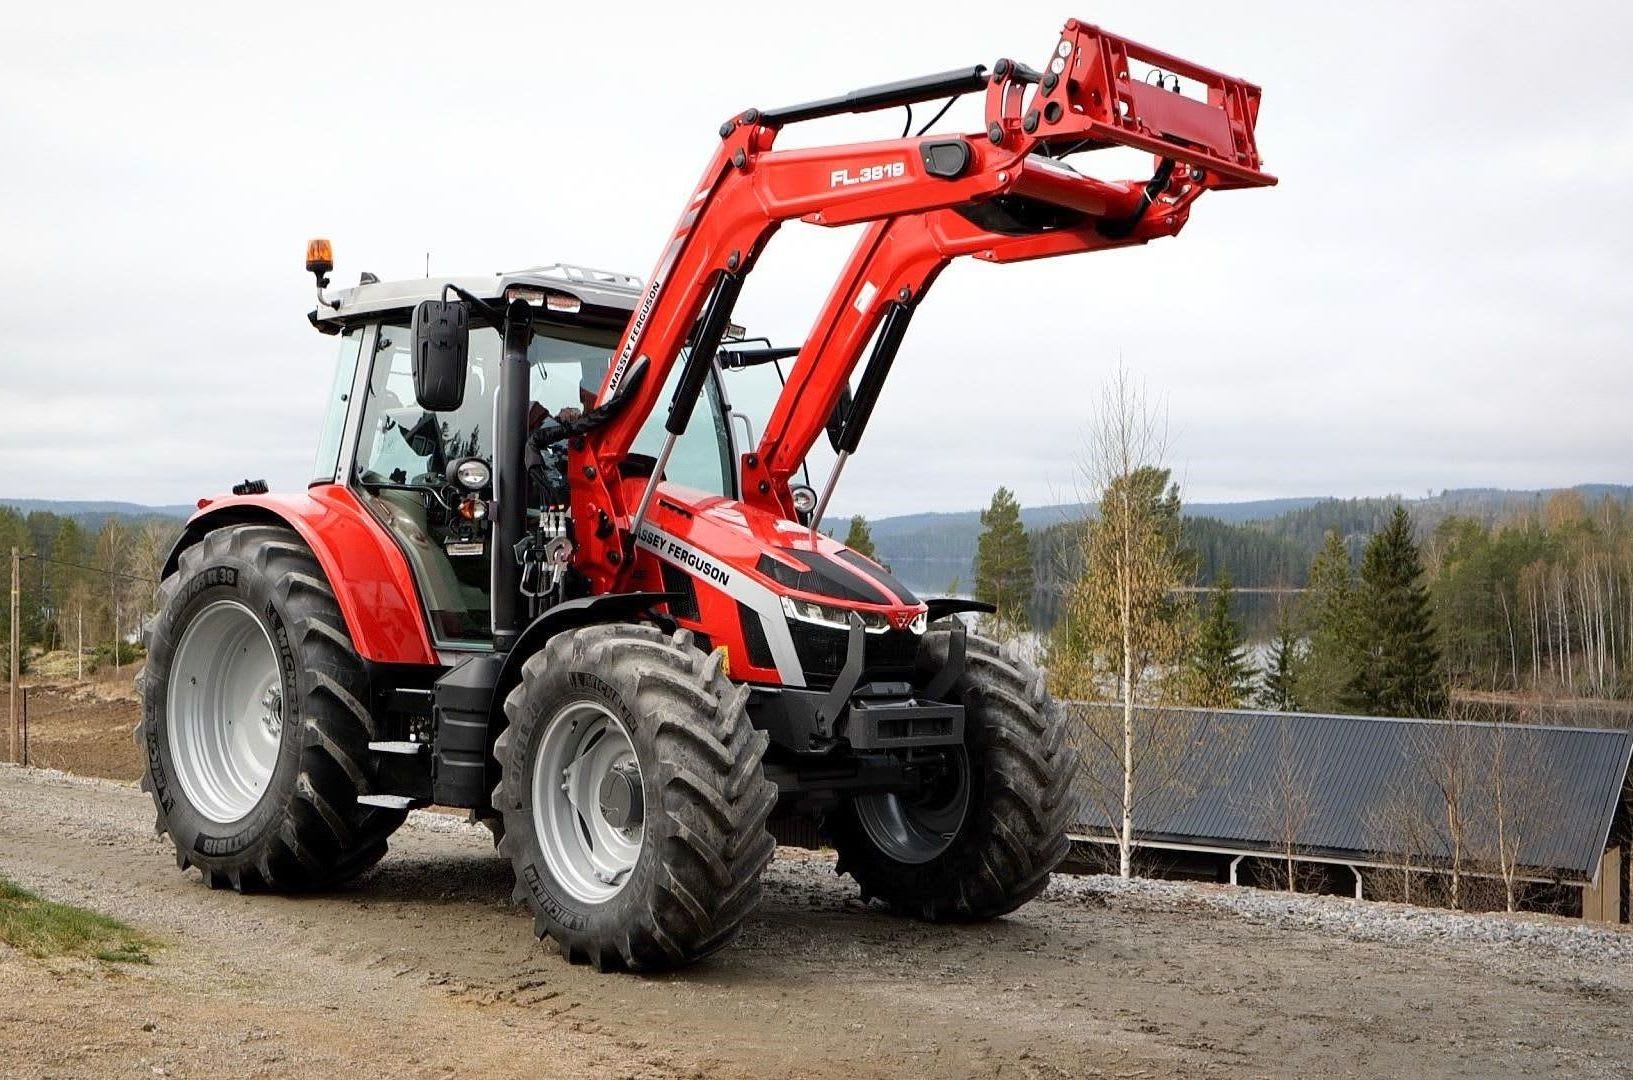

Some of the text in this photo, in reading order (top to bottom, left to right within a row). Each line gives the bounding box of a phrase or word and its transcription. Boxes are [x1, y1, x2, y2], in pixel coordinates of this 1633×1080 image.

[609, 281, 661, 391] MASSEY FERGUSON
[668, 542, 730, 586] FERGUSON
